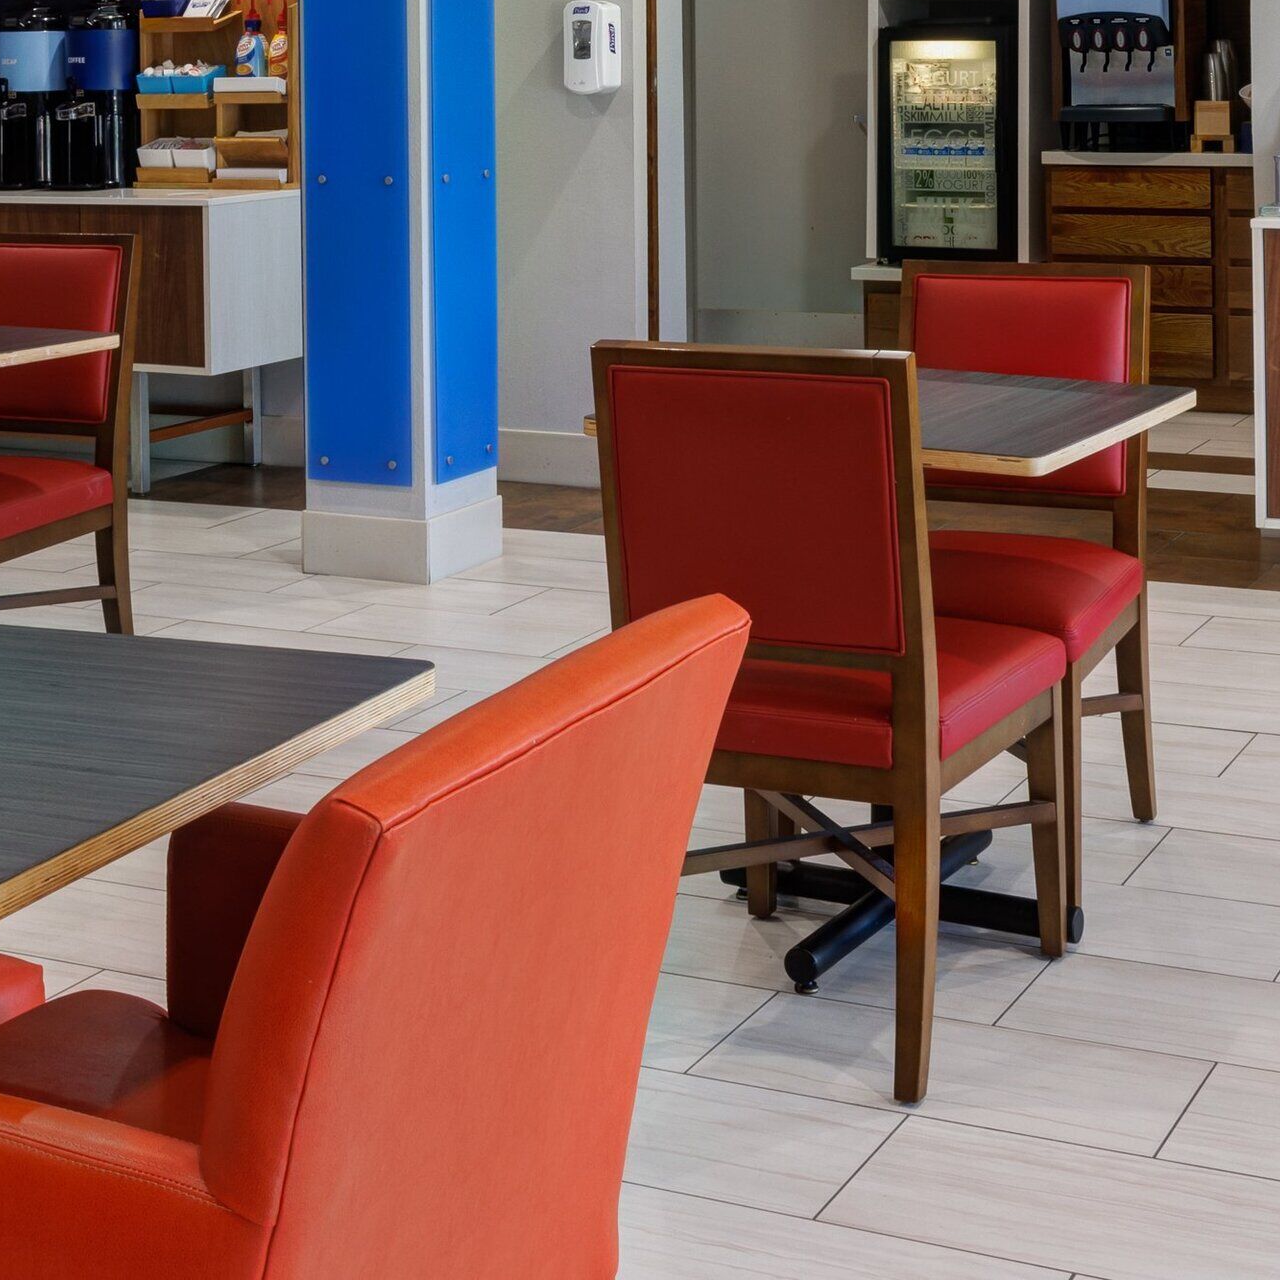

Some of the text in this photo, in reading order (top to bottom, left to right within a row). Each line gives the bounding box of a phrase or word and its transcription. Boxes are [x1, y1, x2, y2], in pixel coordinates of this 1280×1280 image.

[67, 56, 86, 64] COFFEE
[915, 170, 934, 188] 2%
[935, 180, 984, 191] YOGURT
